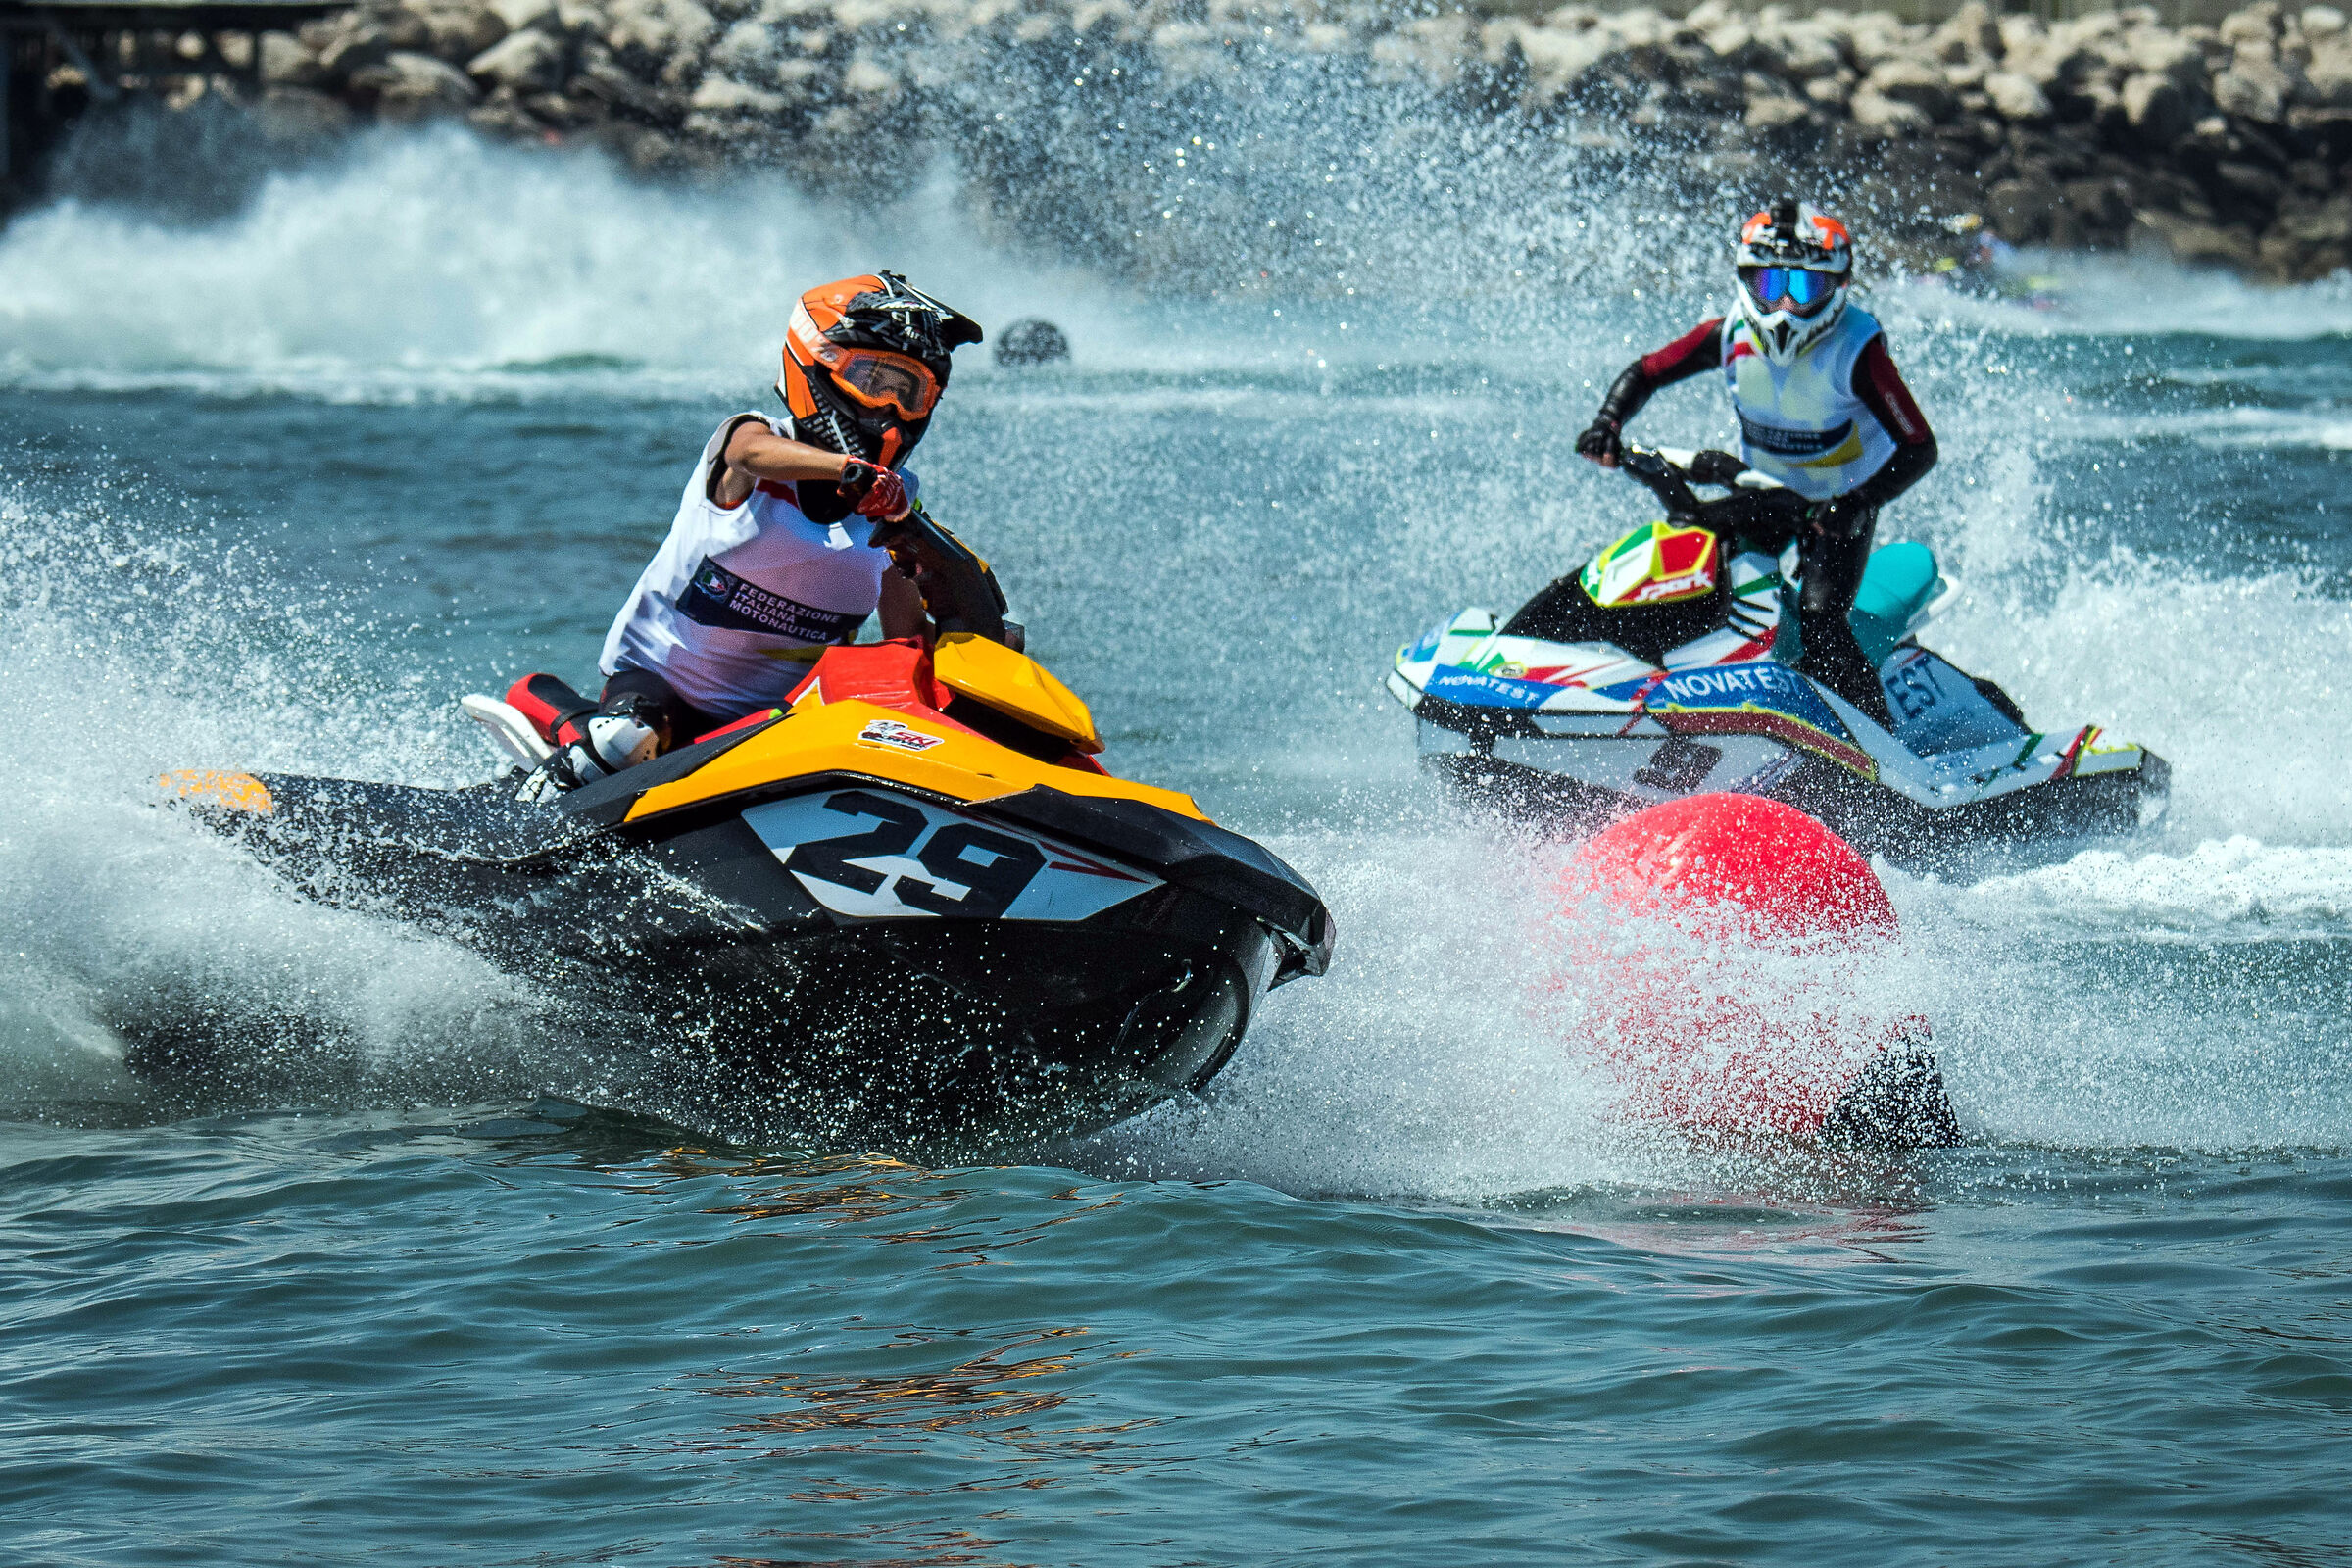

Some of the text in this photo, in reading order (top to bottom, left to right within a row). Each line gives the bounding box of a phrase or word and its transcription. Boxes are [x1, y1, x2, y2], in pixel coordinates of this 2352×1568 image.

[729, 599, 827, 640] MOTONAUTICA
[734, 591, 796, 624] ITALIANA
[739, 583, 840, 623] FEDERAZIONE
[1662, 666, 1799, 702] NOVATEST
[786, 790, 1048, 918] 29
